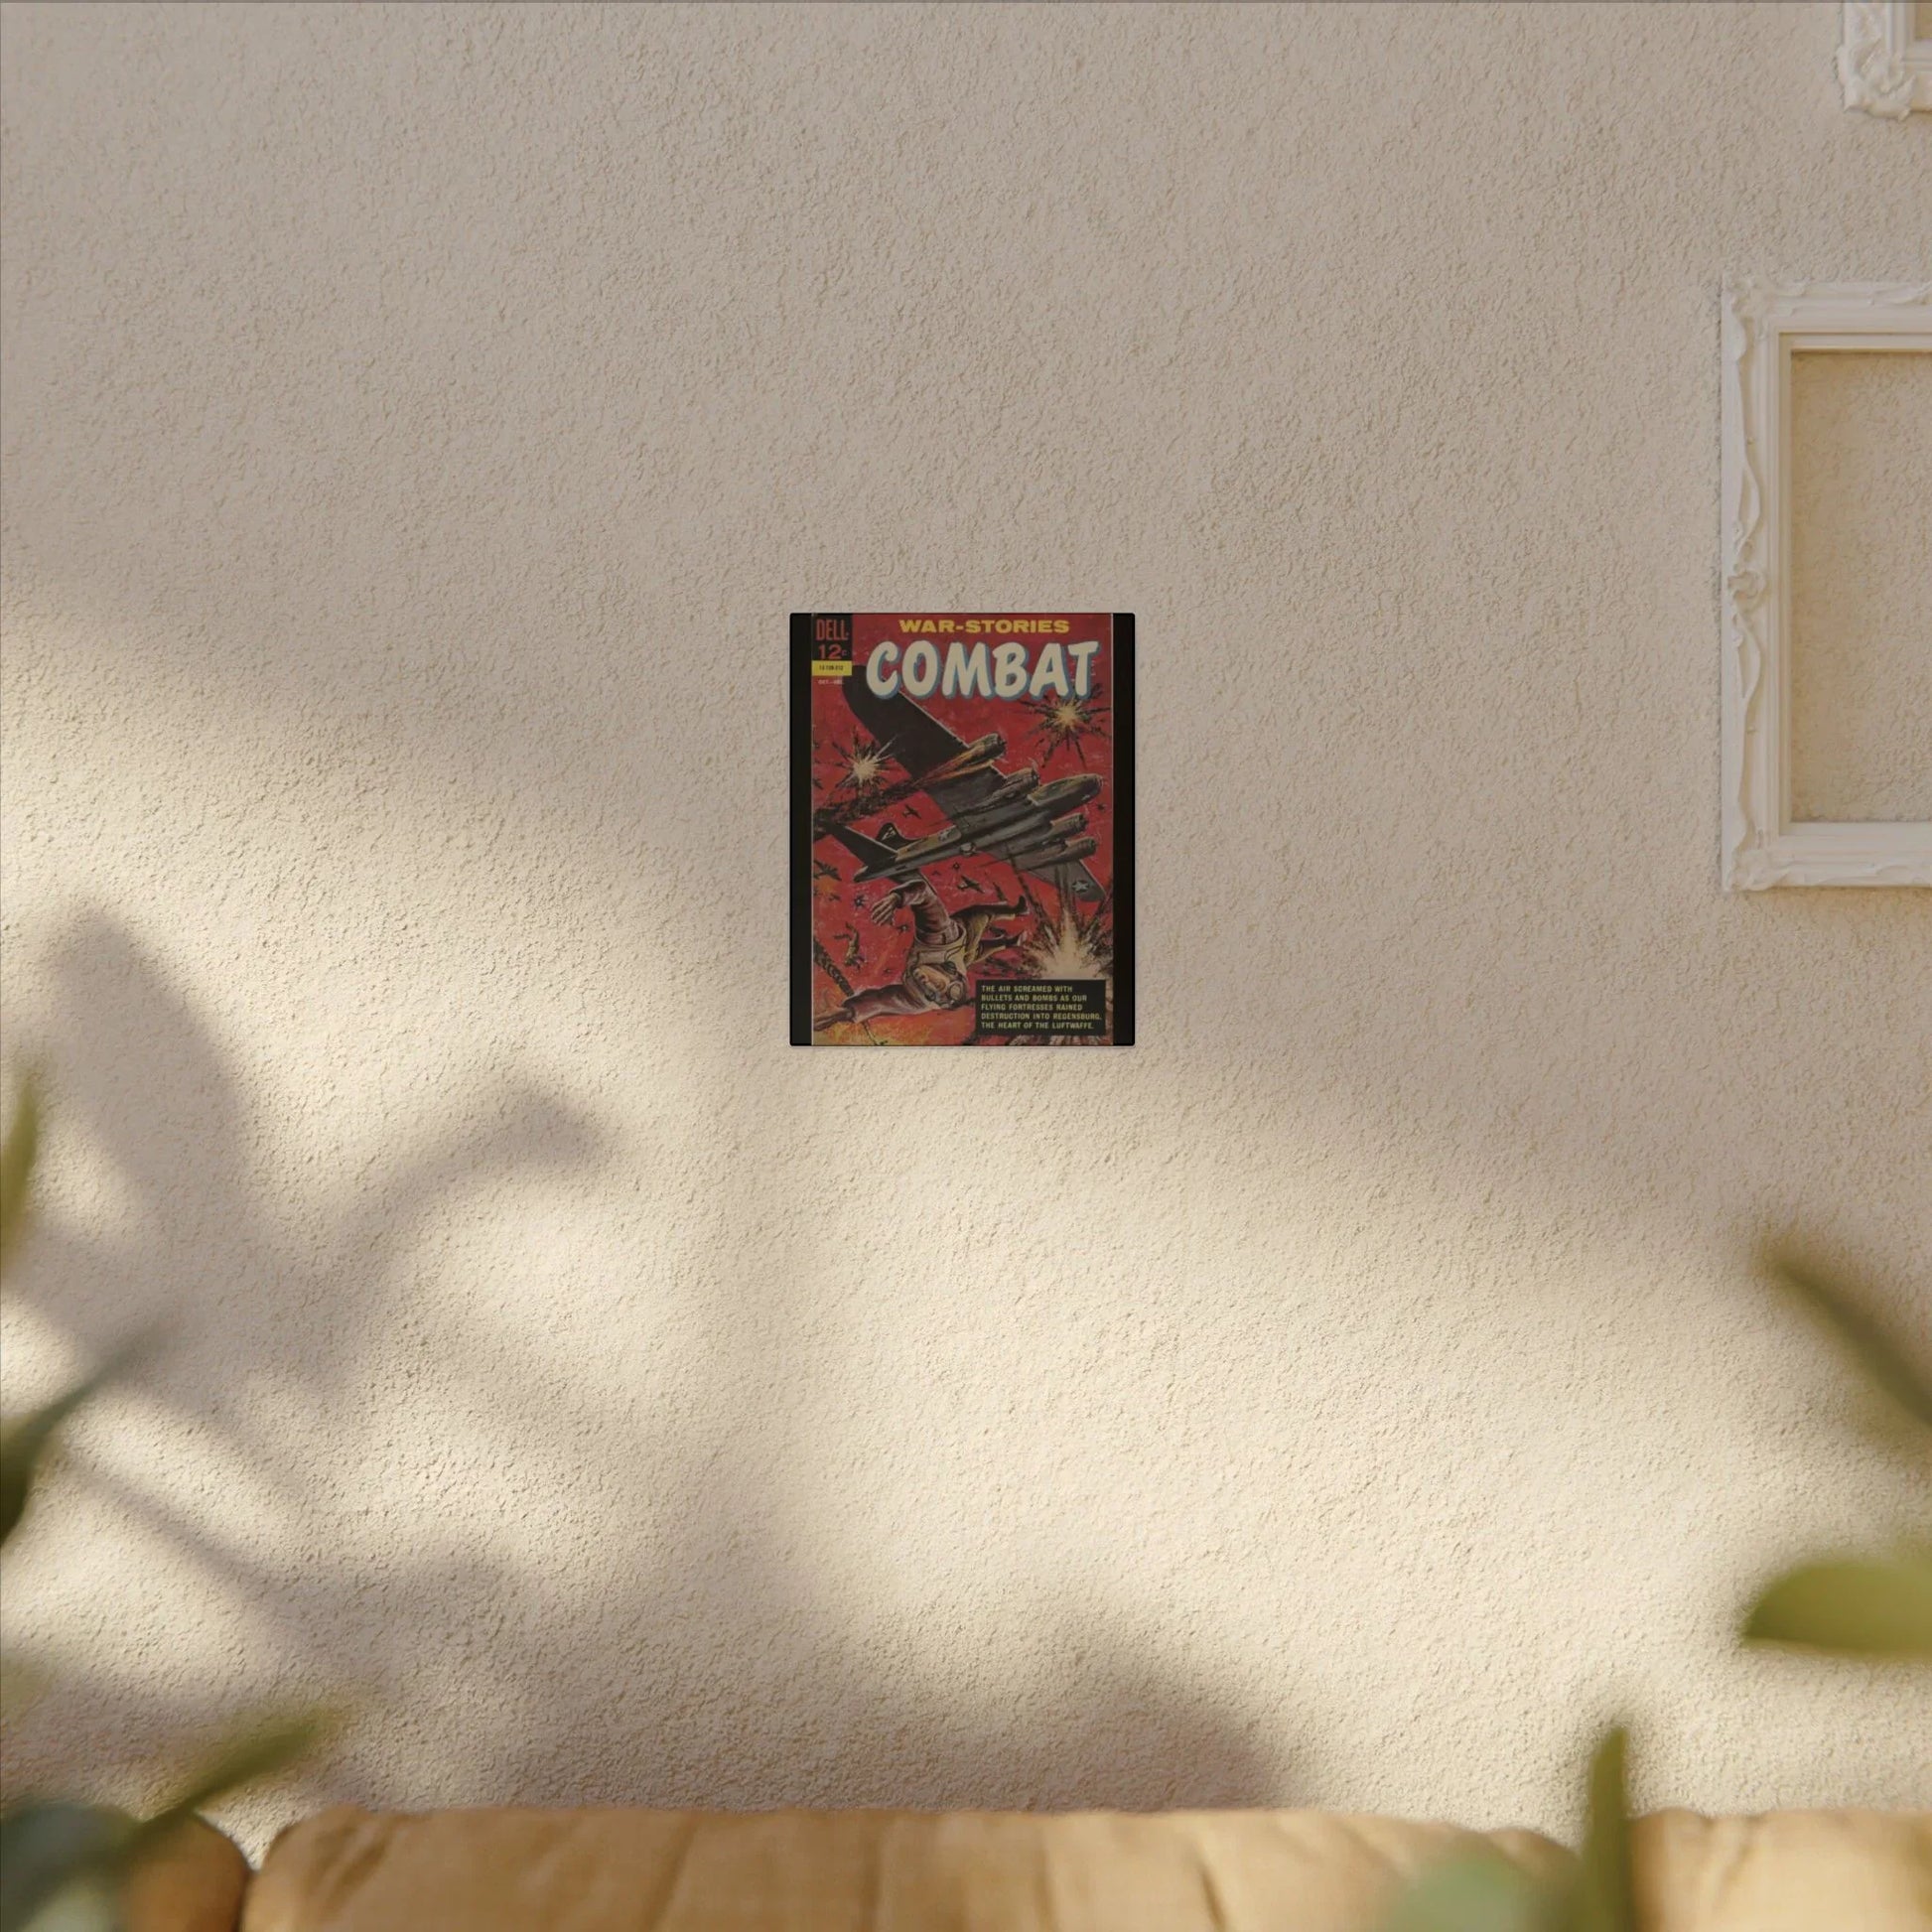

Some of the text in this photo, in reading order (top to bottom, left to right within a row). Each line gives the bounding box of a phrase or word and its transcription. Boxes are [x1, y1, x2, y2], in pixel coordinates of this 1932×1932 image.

[815, 619, 849, 641] DELL
[899, 620, 1070, 633] WAR-STORIES
[866, 640, 1100, 701] COMBAT
